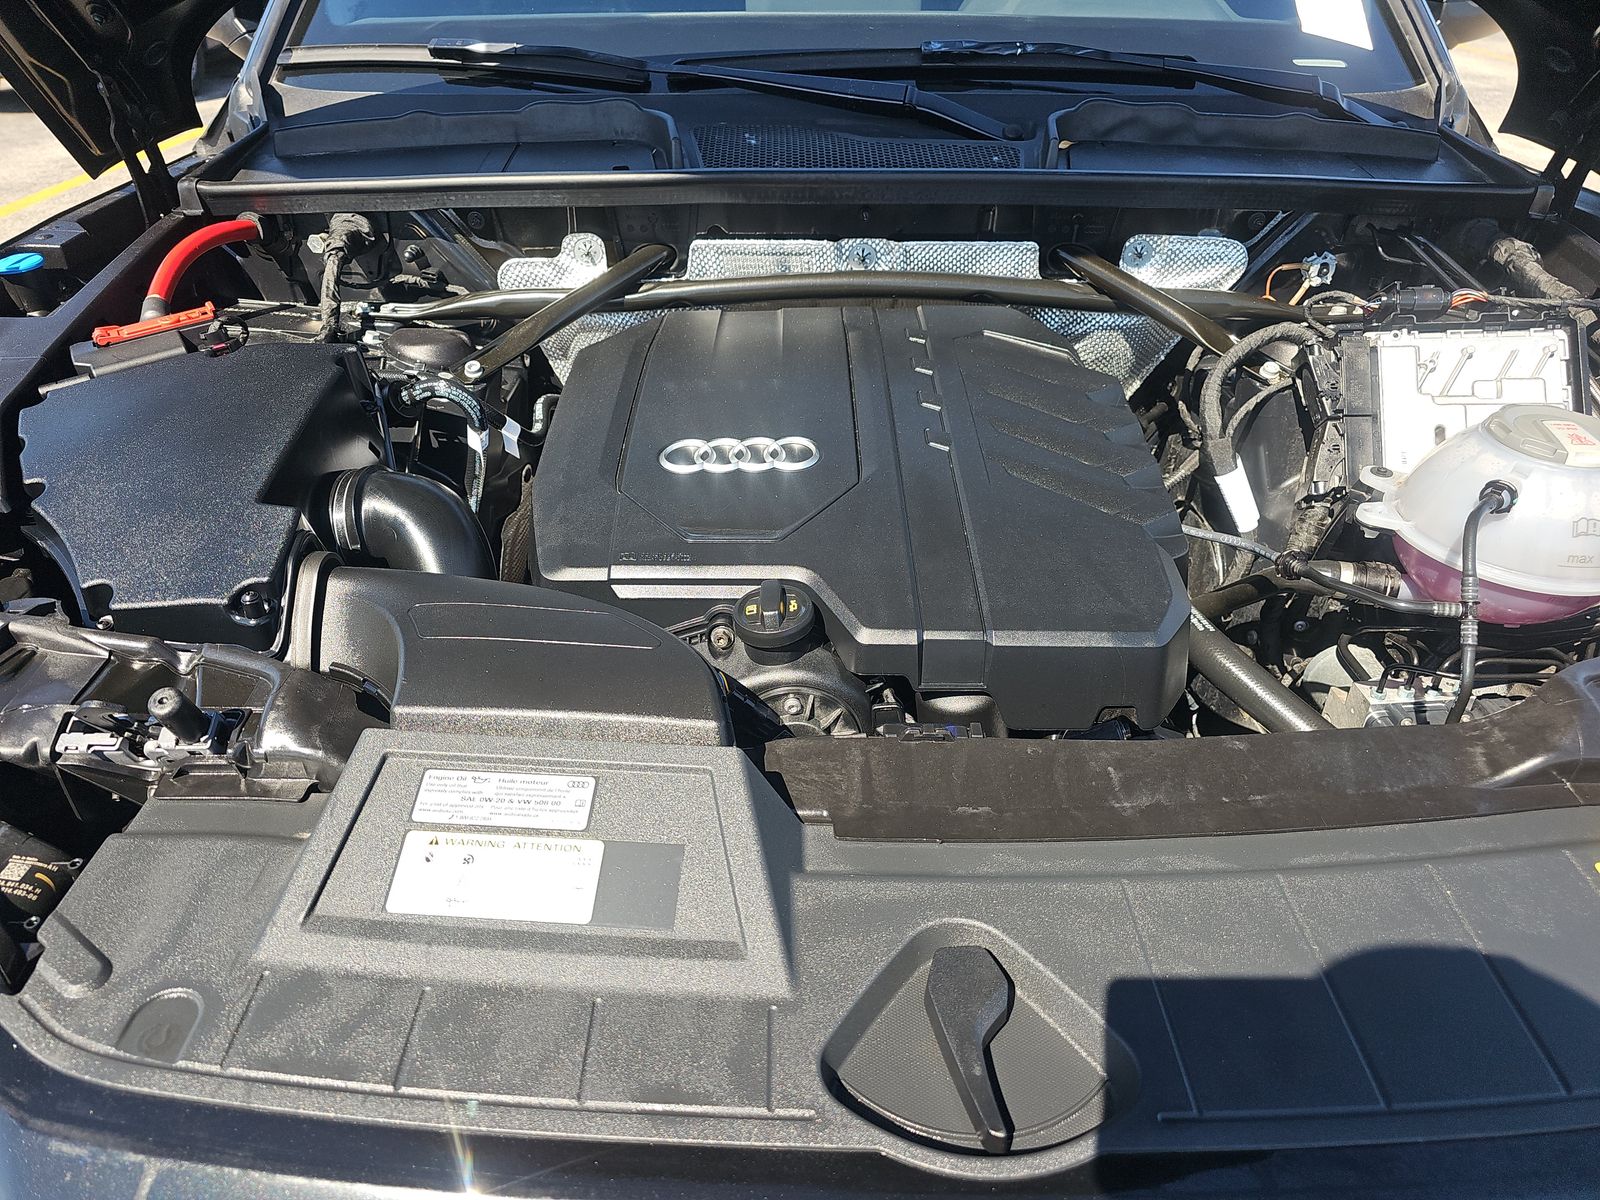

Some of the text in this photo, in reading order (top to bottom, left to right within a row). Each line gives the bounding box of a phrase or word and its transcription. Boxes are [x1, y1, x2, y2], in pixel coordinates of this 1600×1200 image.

[1566, 554, 1595, 564] max
[445, 837, 582, 853] WARNING ATTENTION
